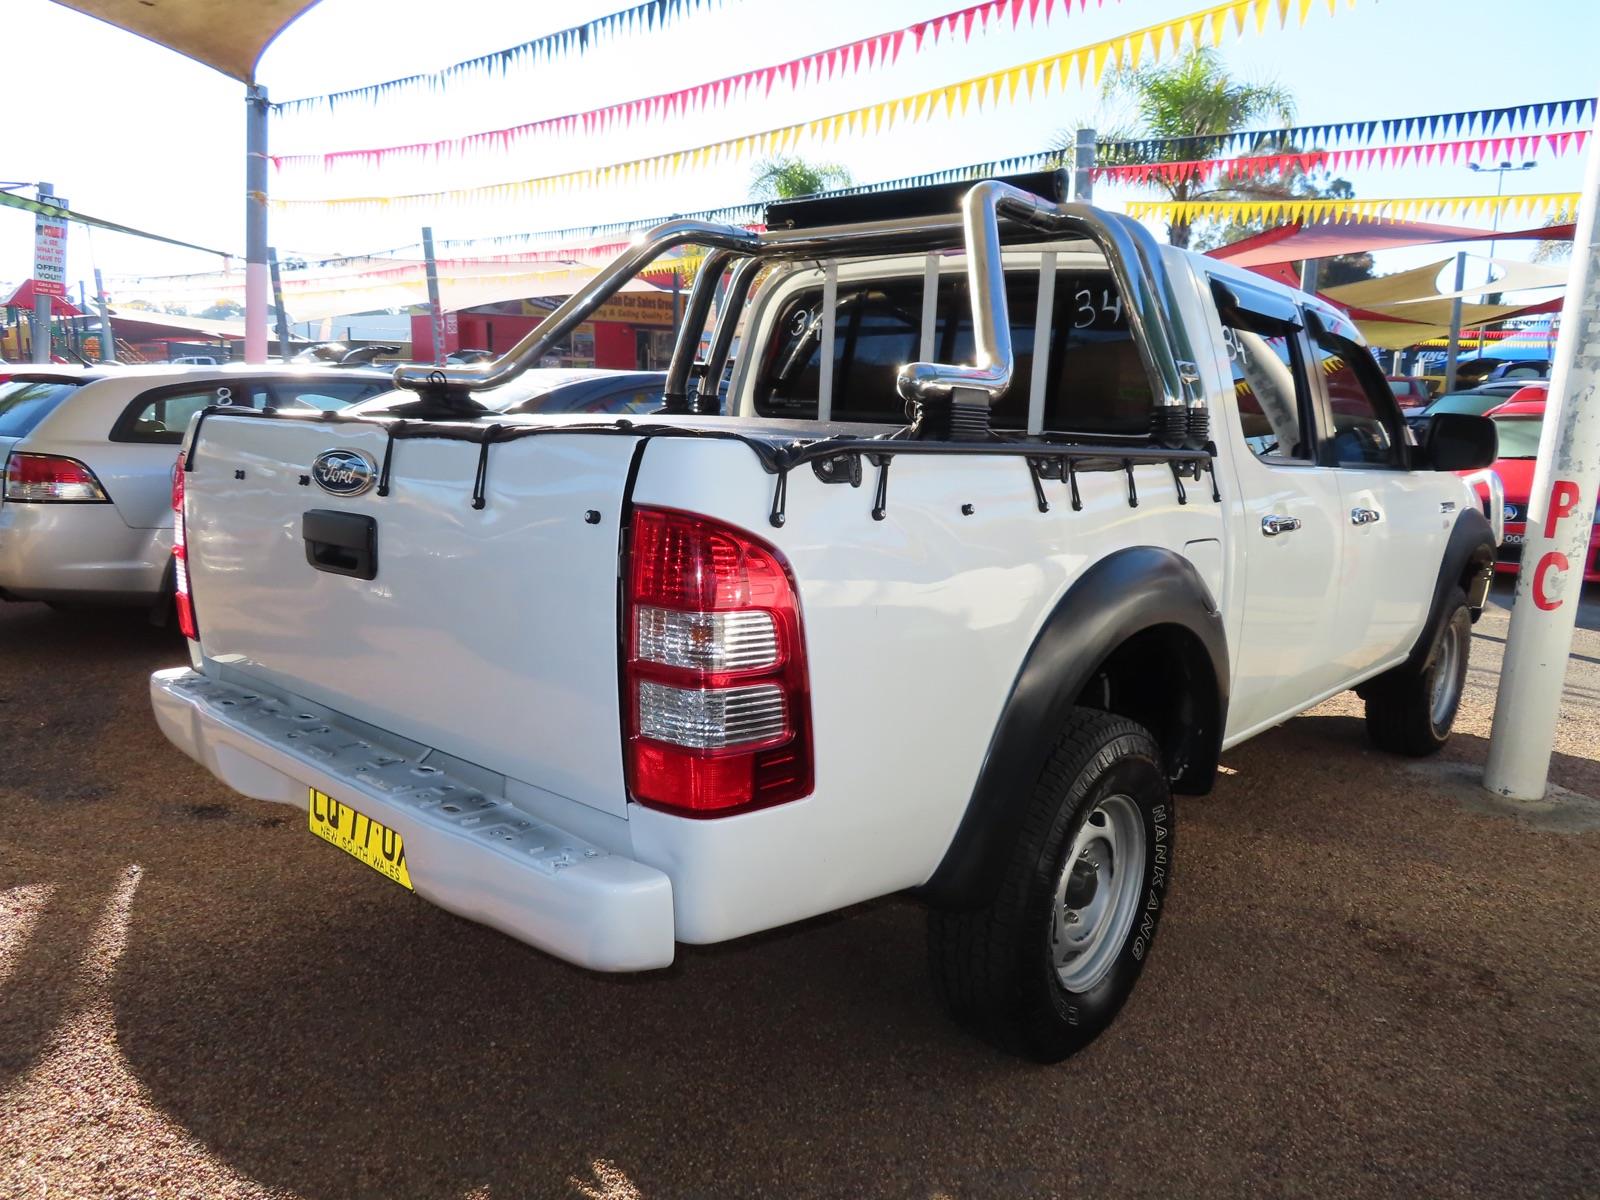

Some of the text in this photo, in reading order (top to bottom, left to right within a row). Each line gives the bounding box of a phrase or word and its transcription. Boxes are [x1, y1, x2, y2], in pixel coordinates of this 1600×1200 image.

[36, 246, 54, 254] WHAT
[36, 254, 53, 262] HAVE
[36, 263, 64, 273] OFFER
[624, 295, 636, 307] Car
[637, 296, 656, 309] Sales
[657, 298, 674, 310] Grou
[1074, 289, 1121, 329] 34
[320, 457, 356, 484] Ford
[320, 825, 400, 881] NEW SOUTH WALES
[1132, 804, 1168, 961] NANKANG
